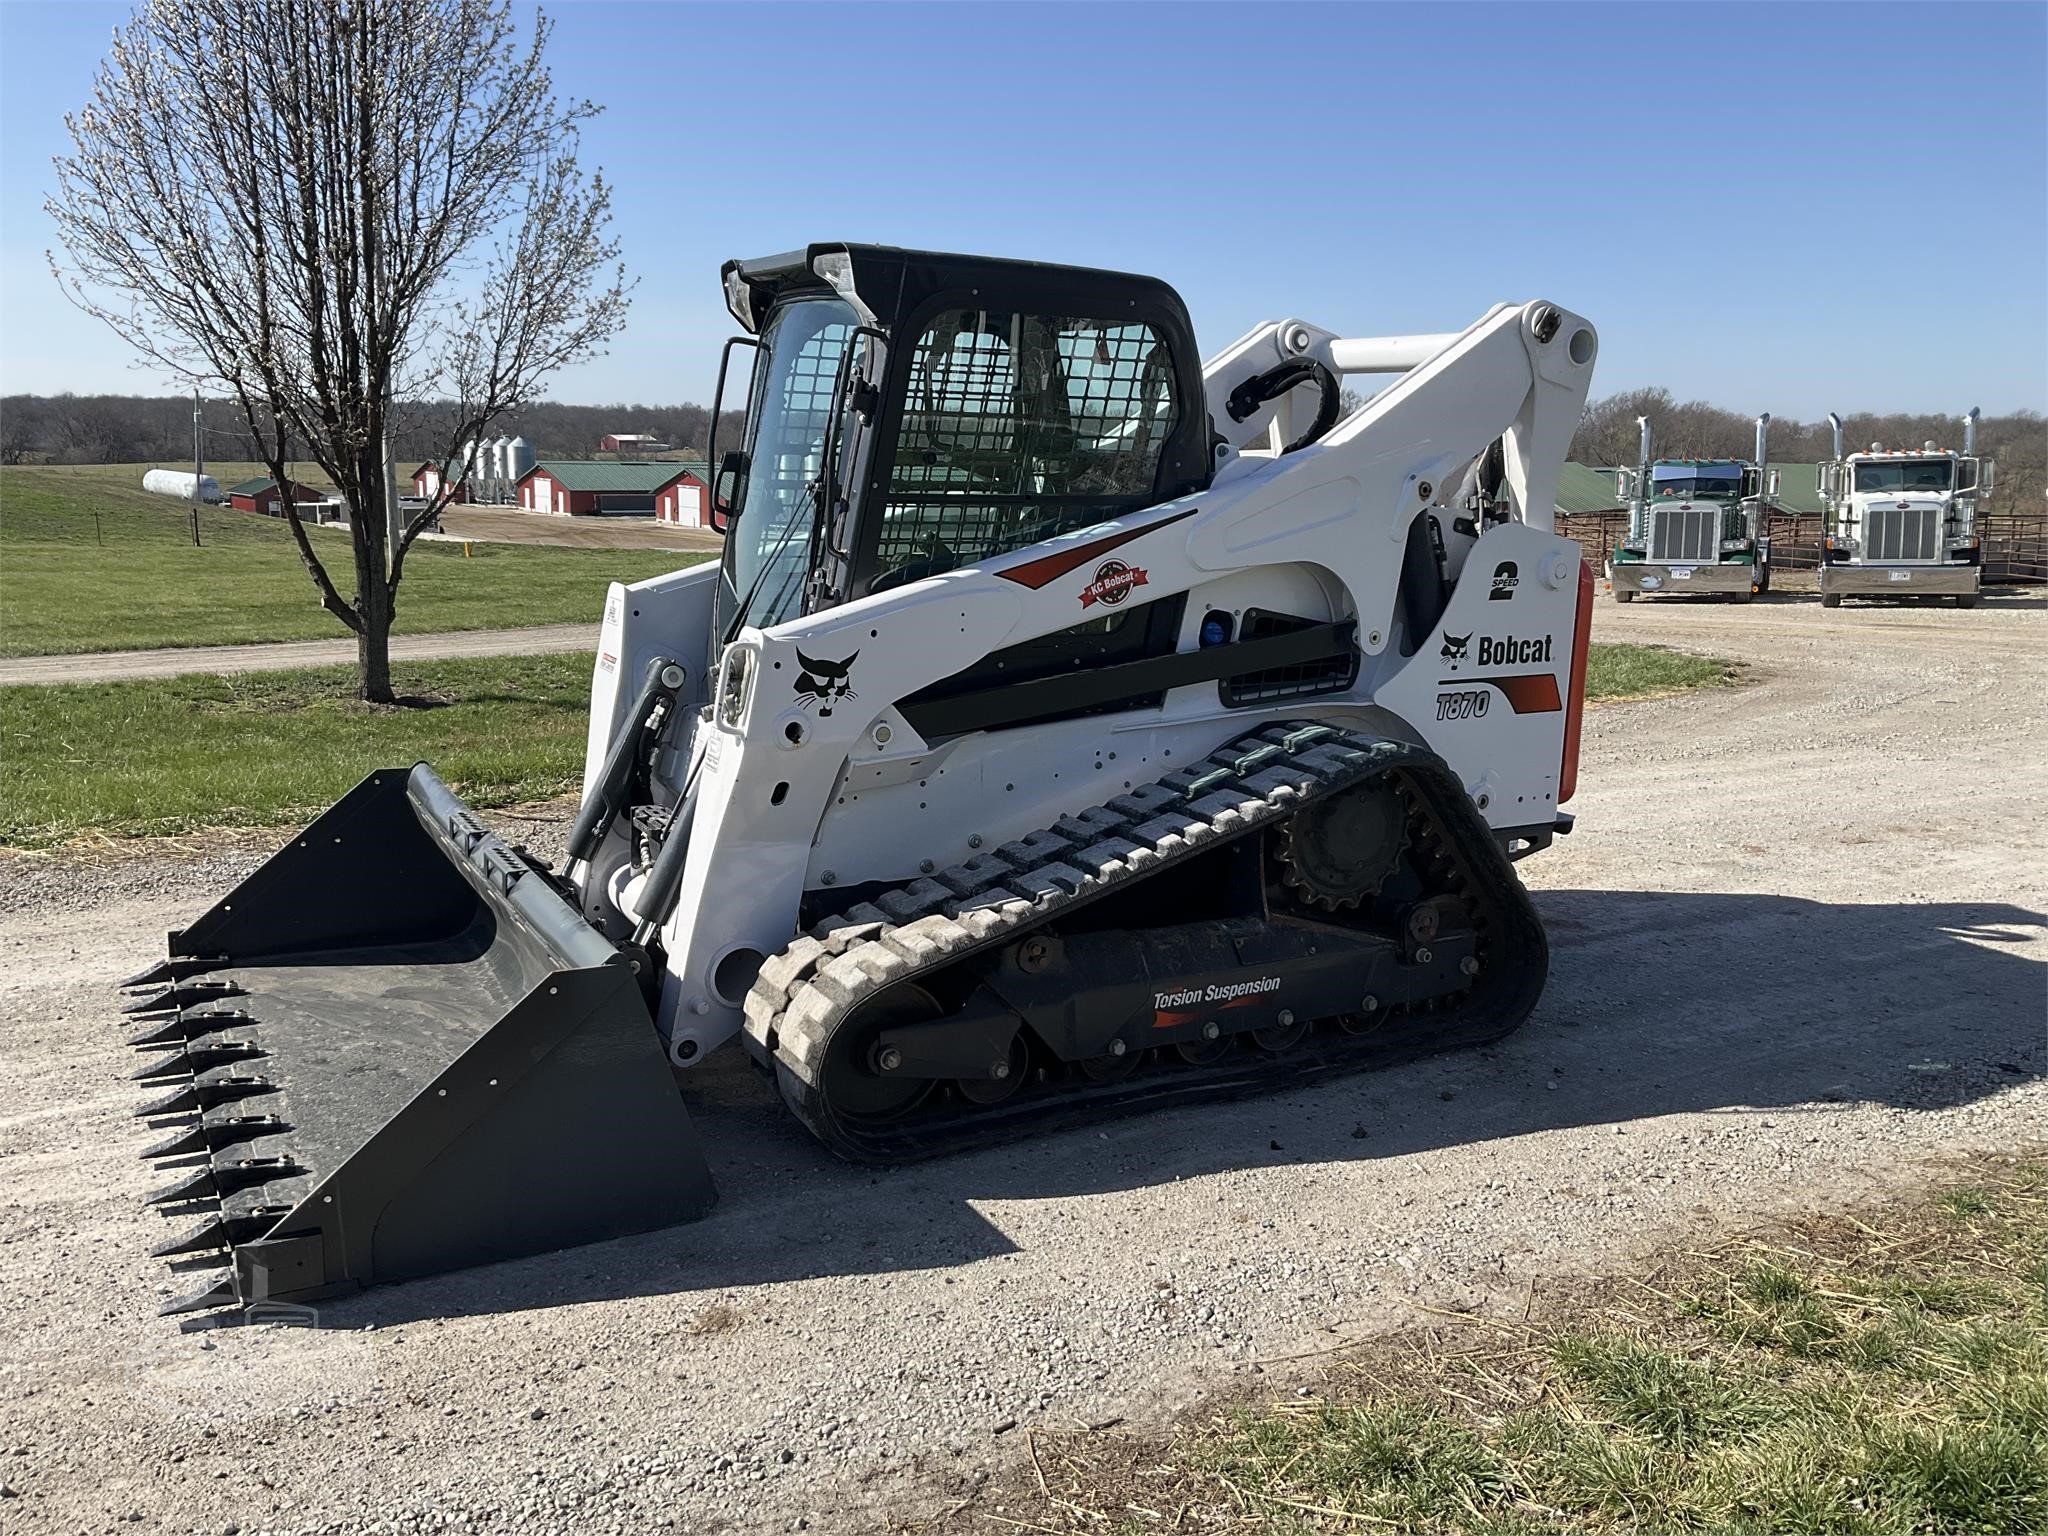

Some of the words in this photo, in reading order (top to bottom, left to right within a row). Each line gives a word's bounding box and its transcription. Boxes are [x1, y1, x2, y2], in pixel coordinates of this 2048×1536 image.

[1091, 583, 1104, 595] KC
[1104, 571, 1134, 589] Bobcat
[1489, 561, 1518, 600] 2
[1492, 578, 1519, 587] SPEED
[1478, 635, 1552, 665] Bobcat
[1437, 690, 1490, 720] T870
[1154, 989, 1203, 1009] Torsion
[1204, 976, 1281, 1001] Suspension
